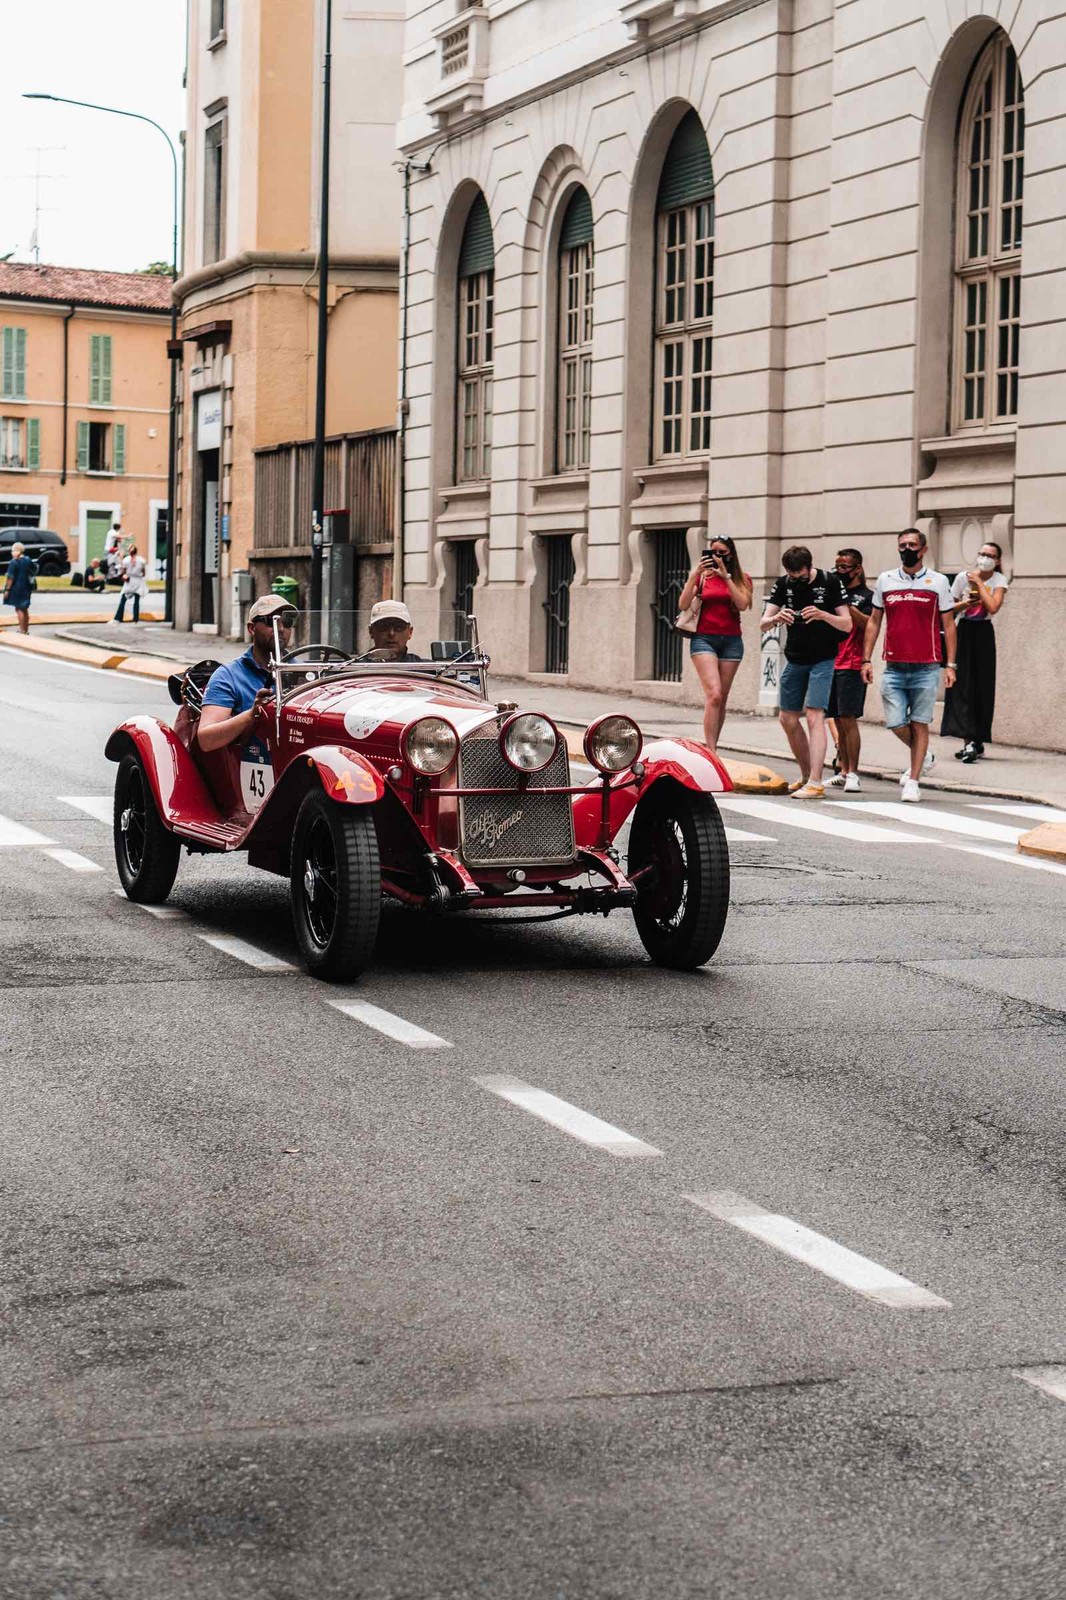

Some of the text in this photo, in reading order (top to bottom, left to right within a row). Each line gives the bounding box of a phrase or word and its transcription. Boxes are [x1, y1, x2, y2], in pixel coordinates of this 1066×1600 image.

[885, 593, 931, 605] Alfa Romeo
[249, 769, 265, 798] 43
[469, 810, 523, 848] Alfa Romeo
